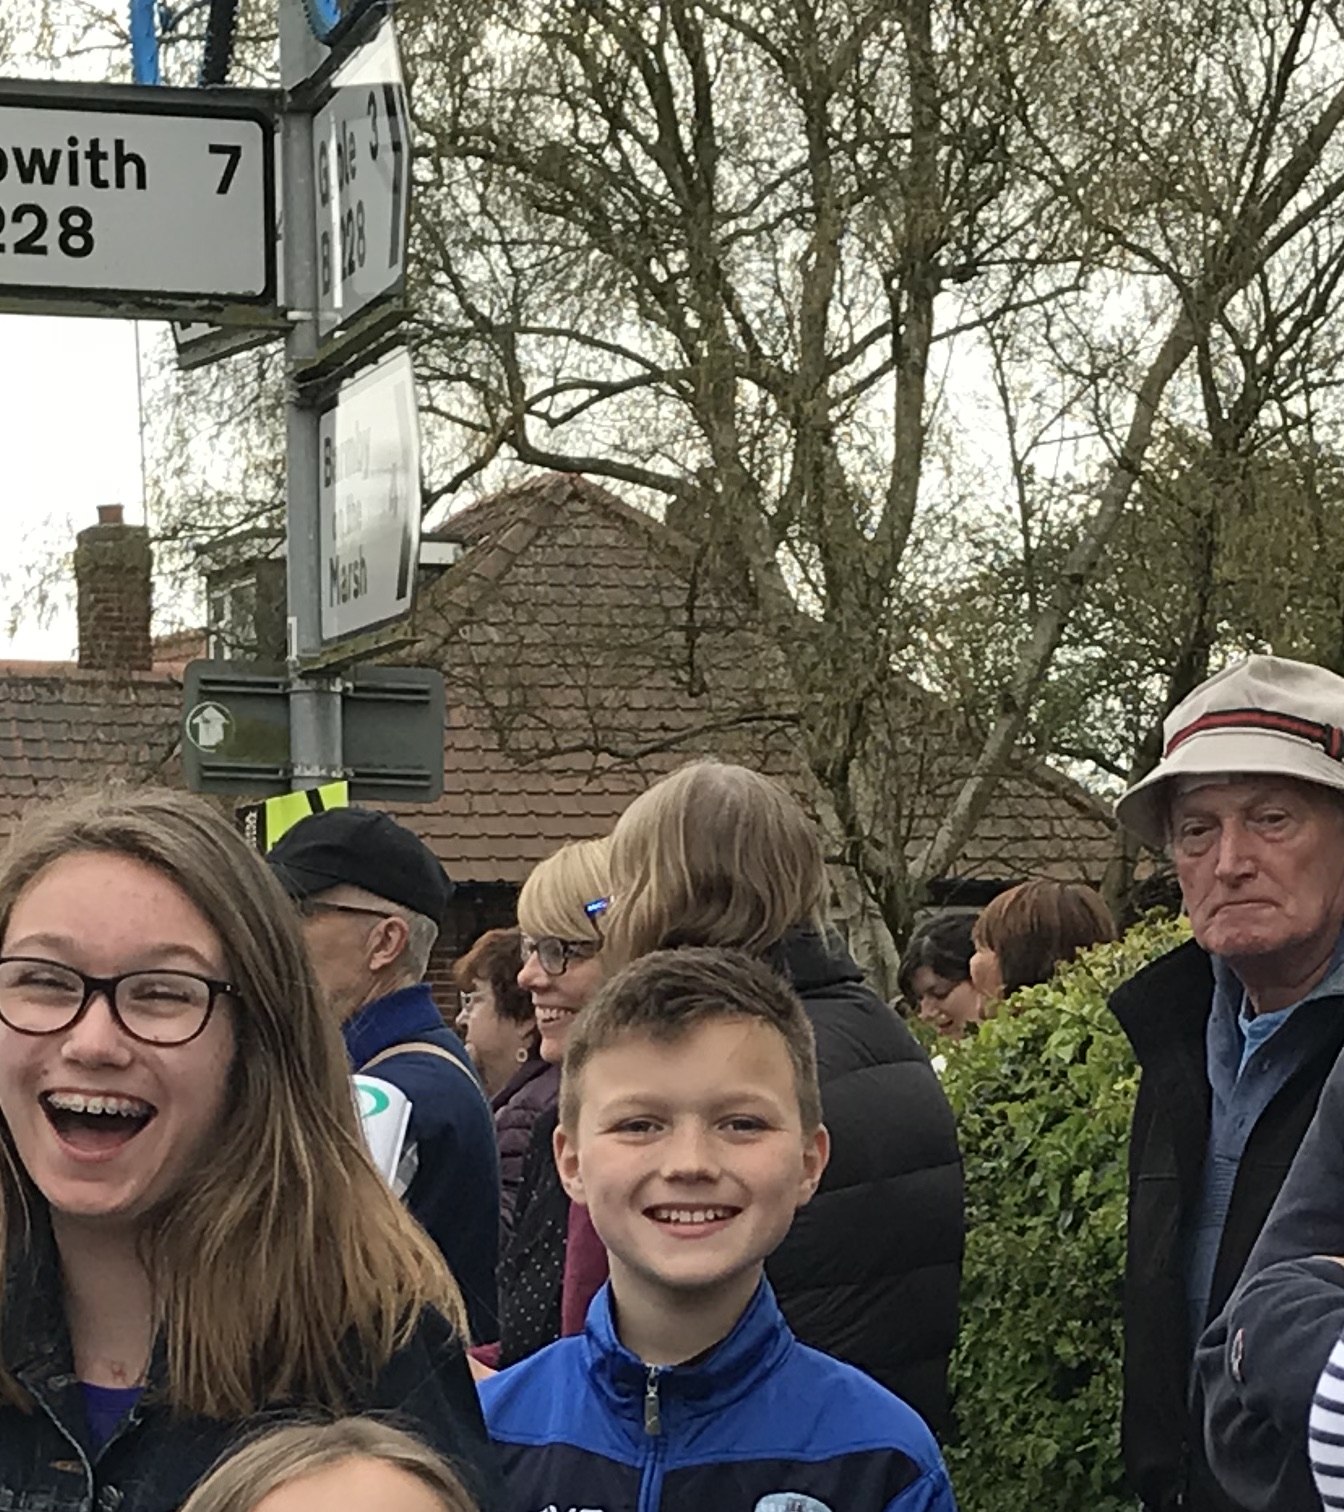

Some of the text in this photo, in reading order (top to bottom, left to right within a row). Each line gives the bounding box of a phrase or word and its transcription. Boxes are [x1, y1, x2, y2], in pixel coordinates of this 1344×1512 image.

[208, 143, 243, 195] 7
[319, 90, 379, 208] Gole 3
[321, 199, 367, 297] B228
[328, 544, 368, 609] Marsh
